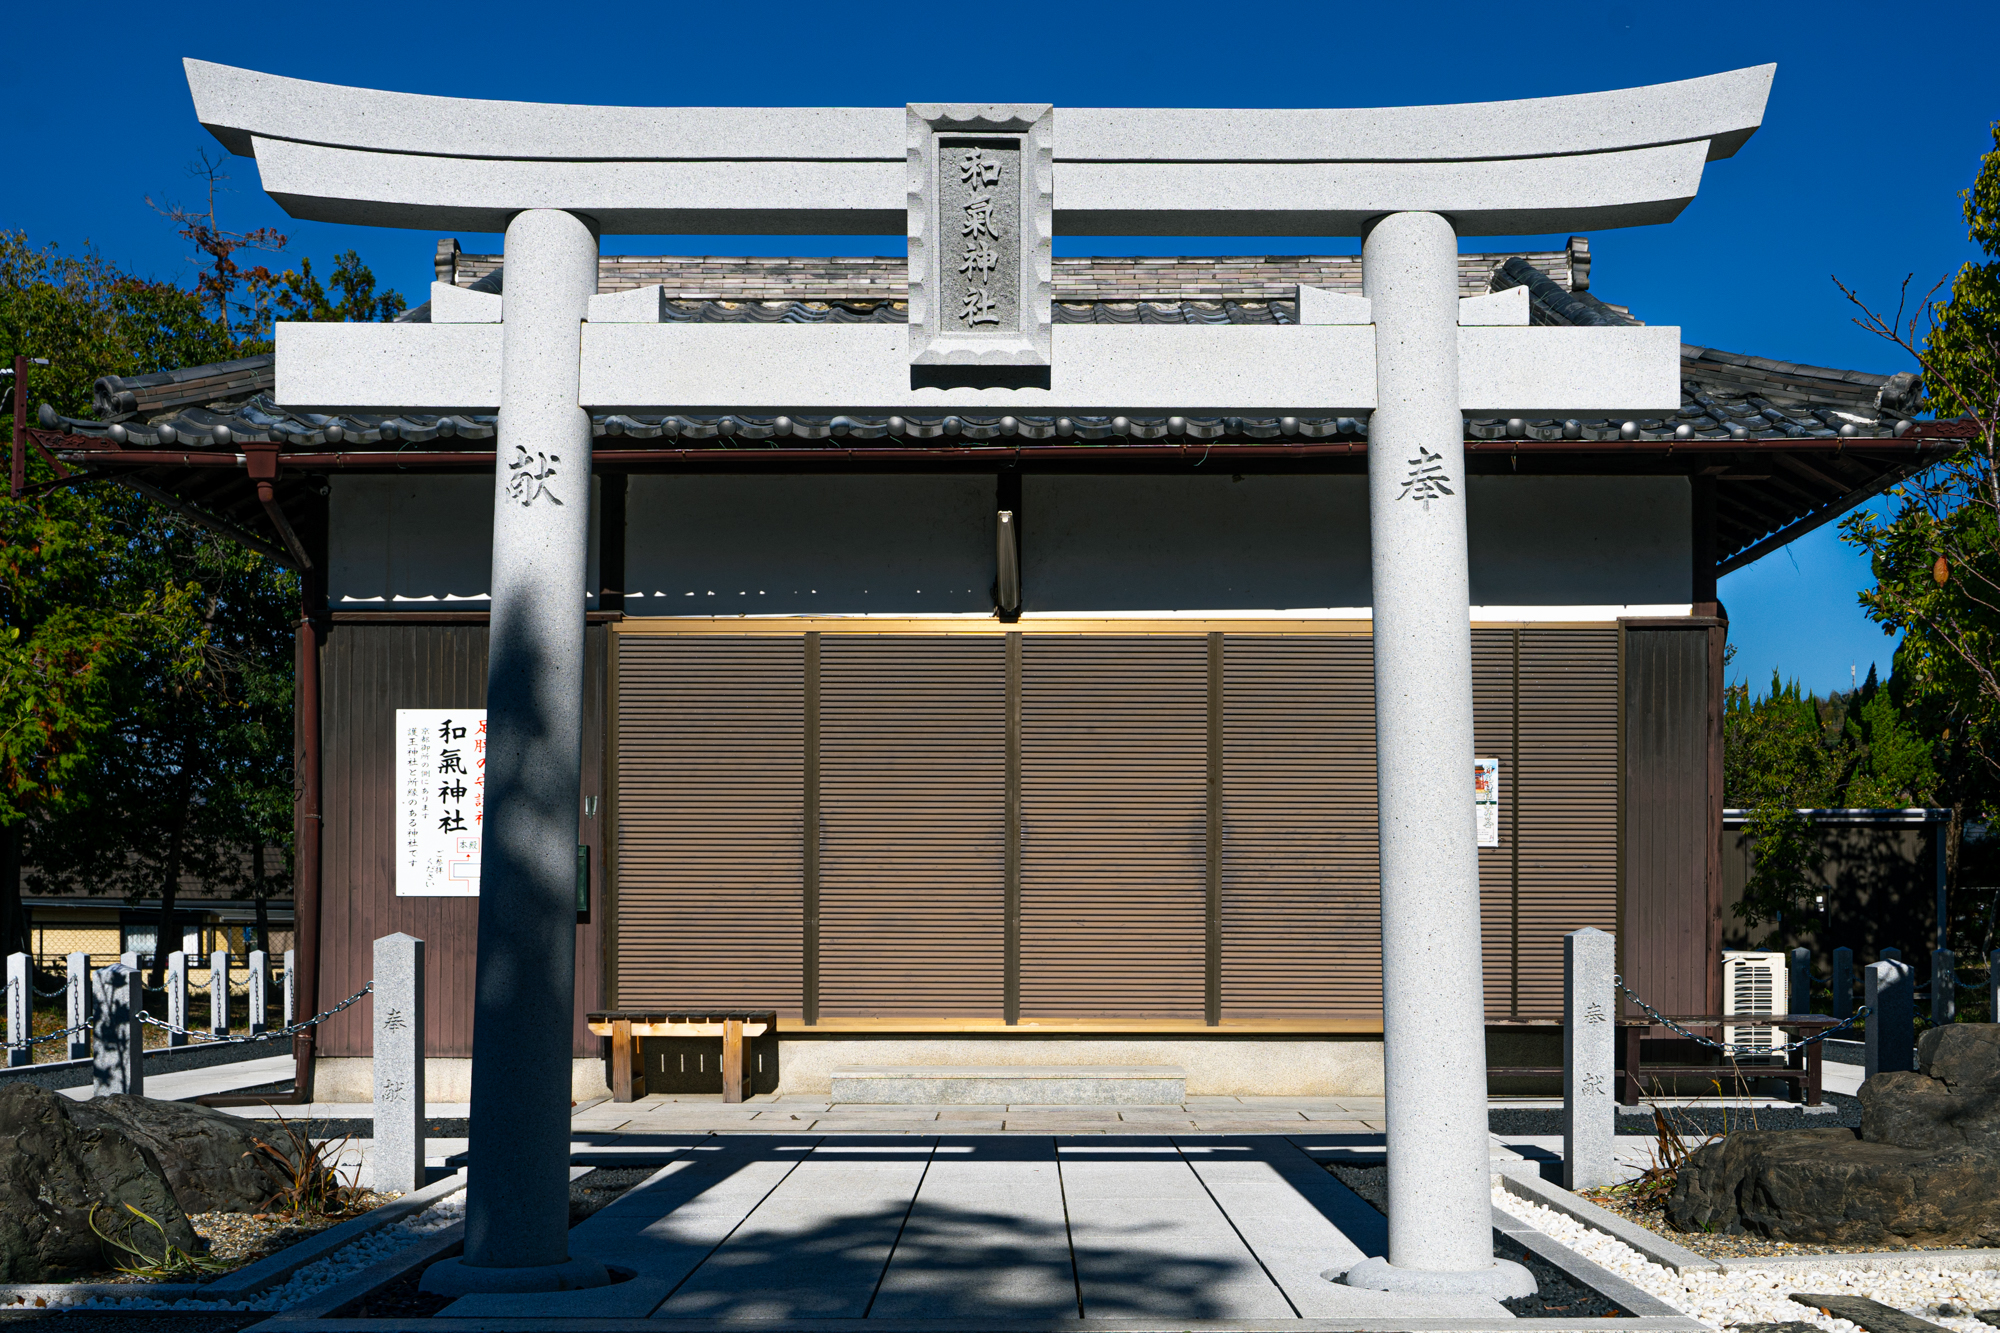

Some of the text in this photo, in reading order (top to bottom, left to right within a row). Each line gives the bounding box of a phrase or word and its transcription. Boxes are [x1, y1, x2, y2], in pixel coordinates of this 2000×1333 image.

[959, 146, 1001, 329] 和氣神社
[1394, 446, 1455, 511] 奉
[437, 718, 468, 835] 和氣神社
